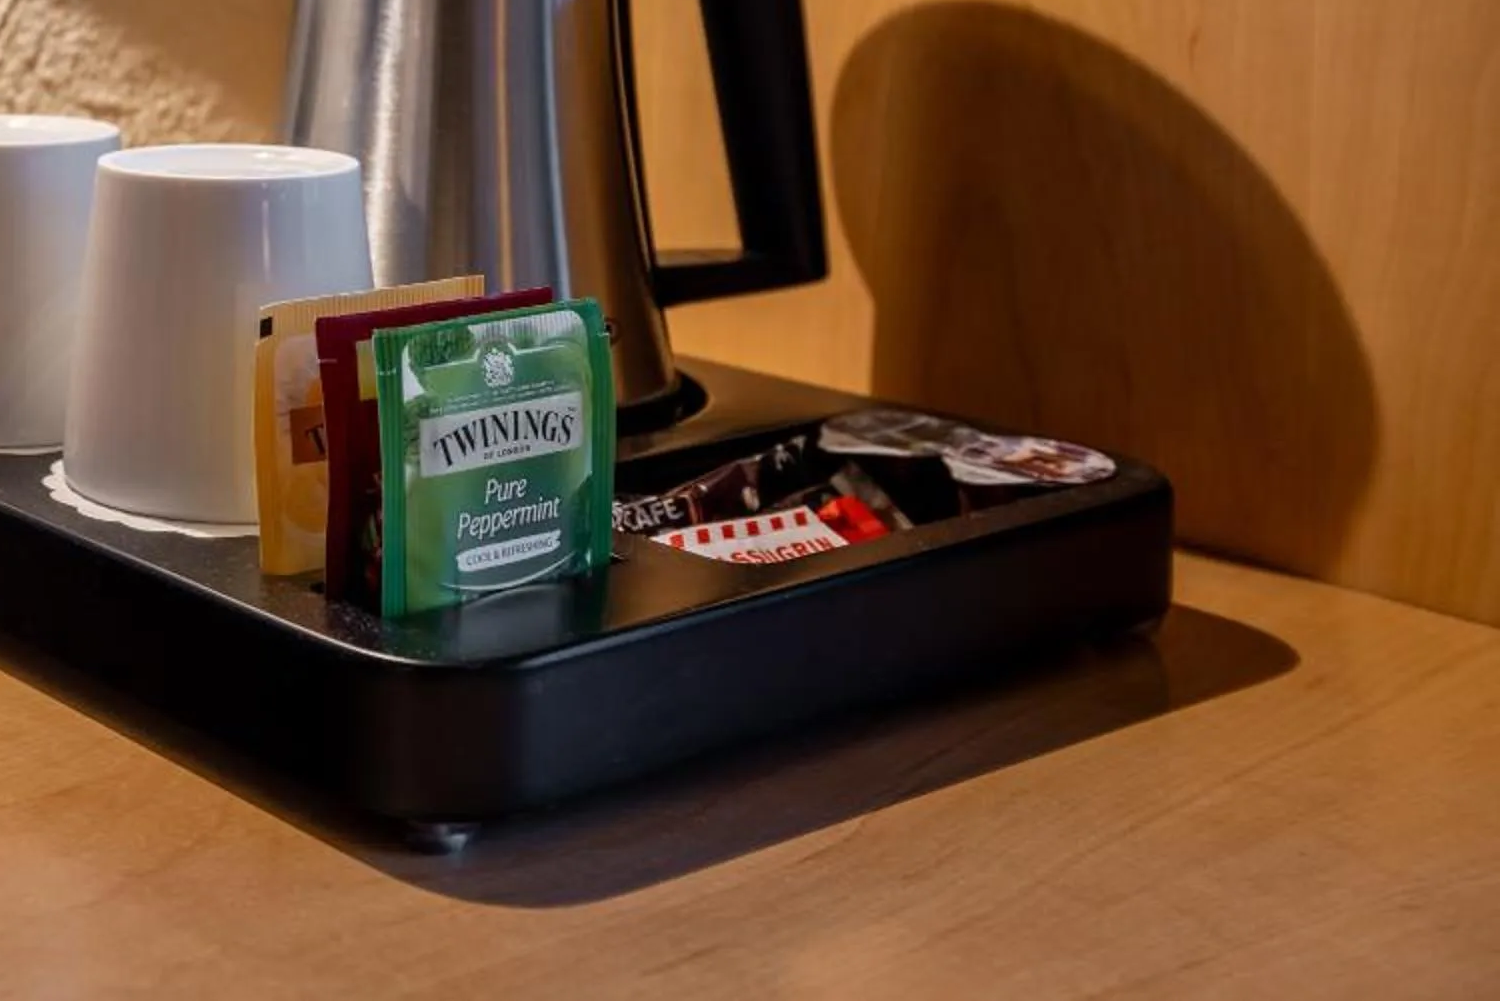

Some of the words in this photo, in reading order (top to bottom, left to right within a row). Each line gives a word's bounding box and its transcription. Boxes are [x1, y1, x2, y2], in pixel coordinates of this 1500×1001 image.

[433, 409, 575, 467] TWININGS
[484, 478, 528, 505] Pure
[457, 497, 561, 540] Peppermint
[716, 537, 834, 564] SSUGRIN
